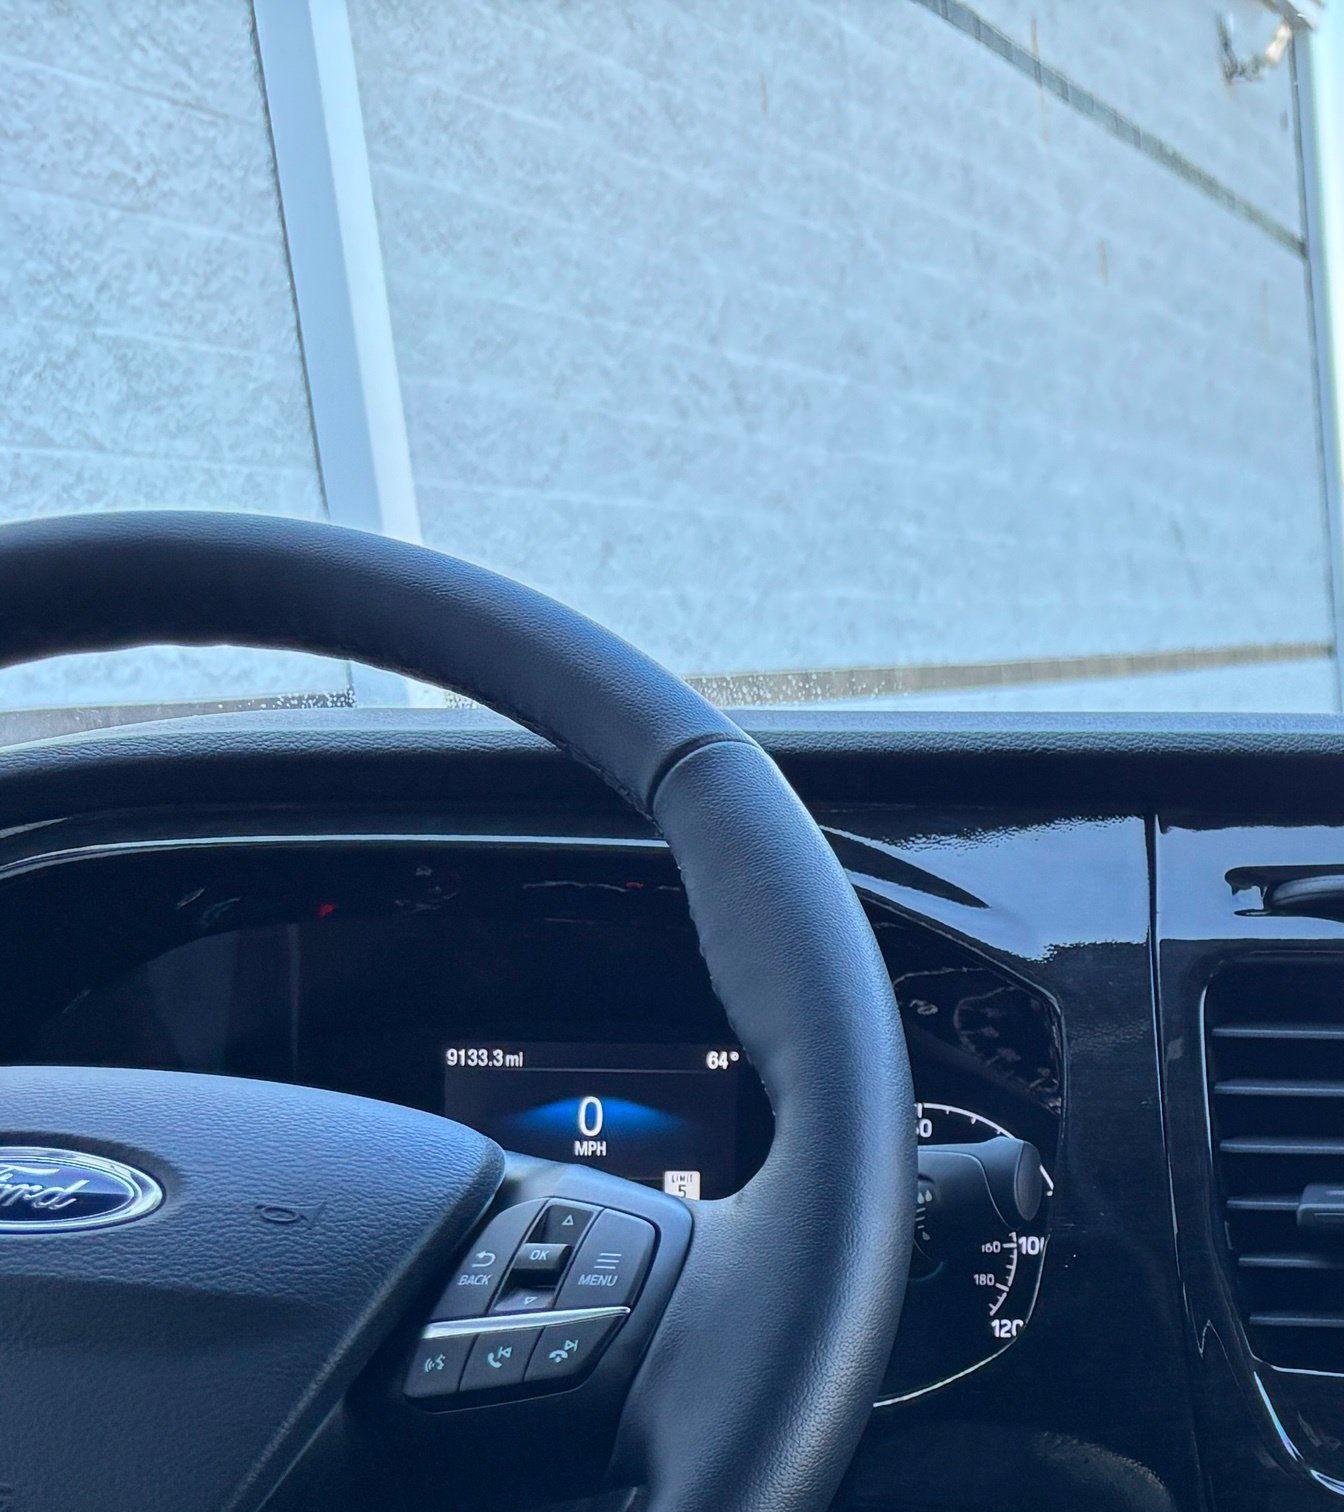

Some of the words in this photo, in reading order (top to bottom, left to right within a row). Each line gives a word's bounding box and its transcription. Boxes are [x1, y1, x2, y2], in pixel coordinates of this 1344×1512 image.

[578, 1096, 603, 1137] 0
[574, 1141, 607, 1157] MPH
[678, 1184, 687, 1199] 5
[530, 1250, 551, 1261] OK
[457, 1273, 493, 1286] BACK
[577, 1273, 618, 1287] MENU
[973, 1273, 995, 1286] 180
